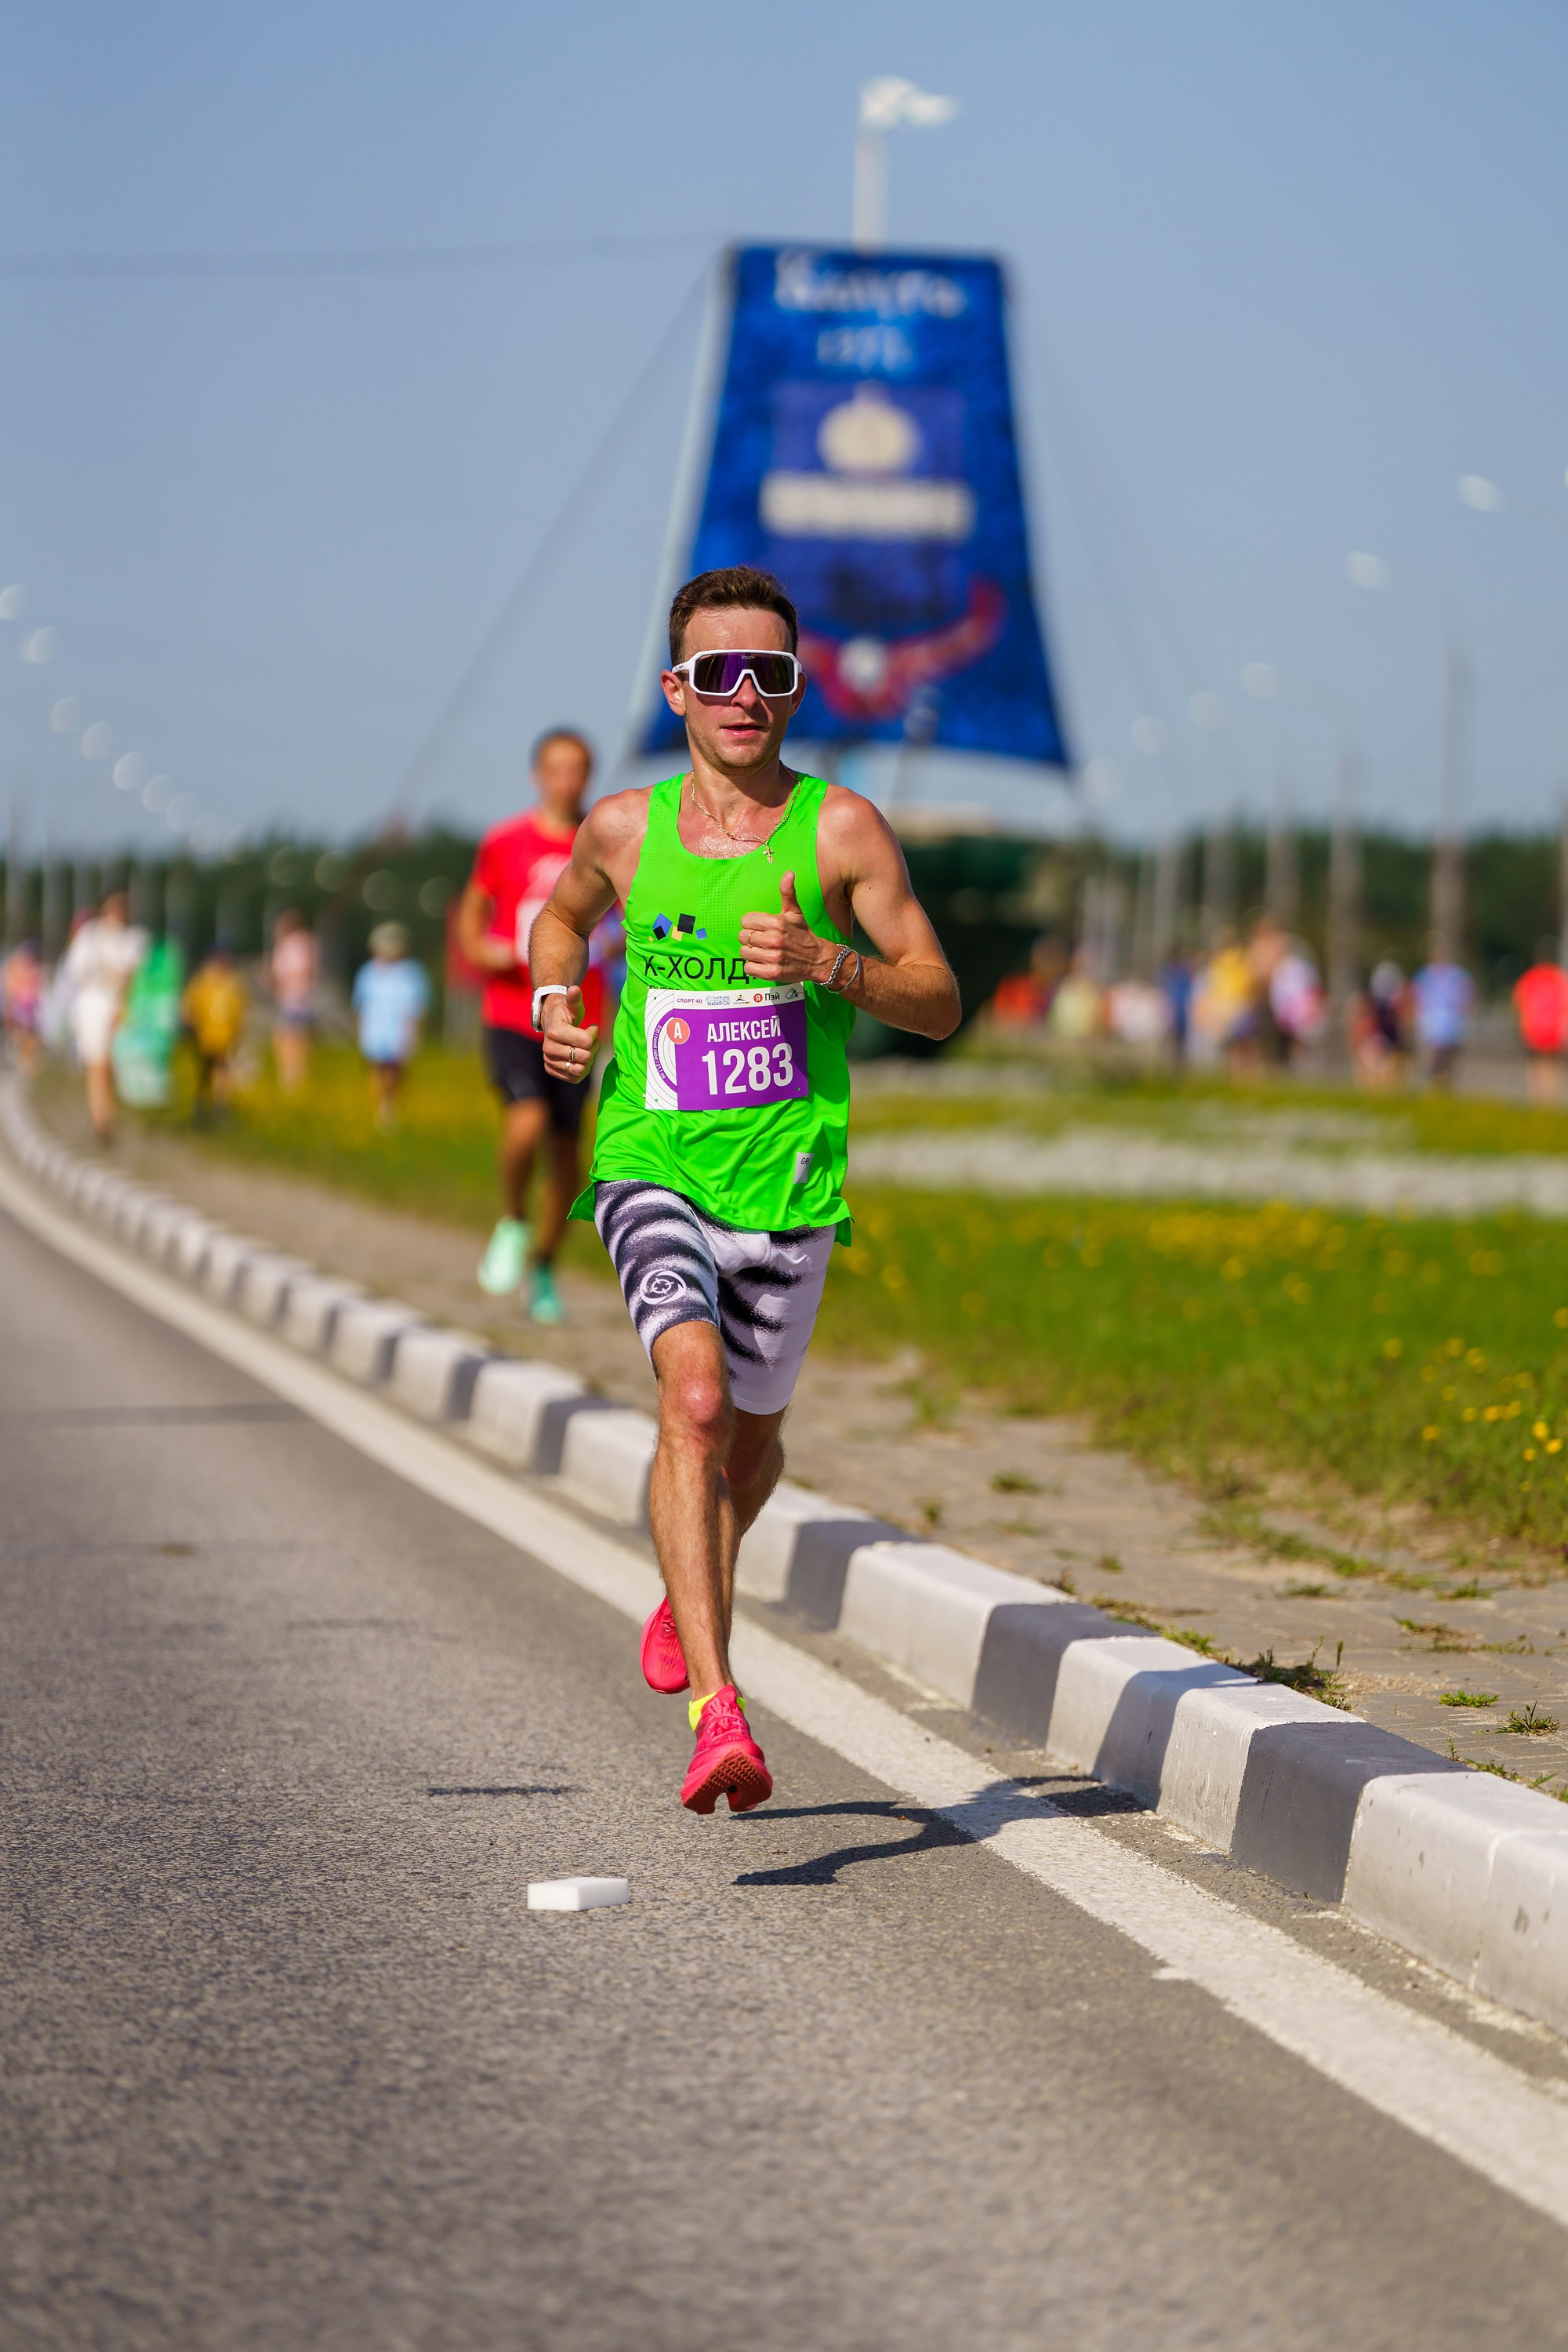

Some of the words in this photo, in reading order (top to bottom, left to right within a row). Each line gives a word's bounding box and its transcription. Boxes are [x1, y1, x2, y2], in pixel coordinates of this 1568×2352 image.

[643, 956, 757, 985] К-ХОЛД
[764, 993, 780, 1001] Пэй
[707, 1015, 781, 1043] АЛЕКСЕЙ
[702, 1043, 793, 1095] 1283
